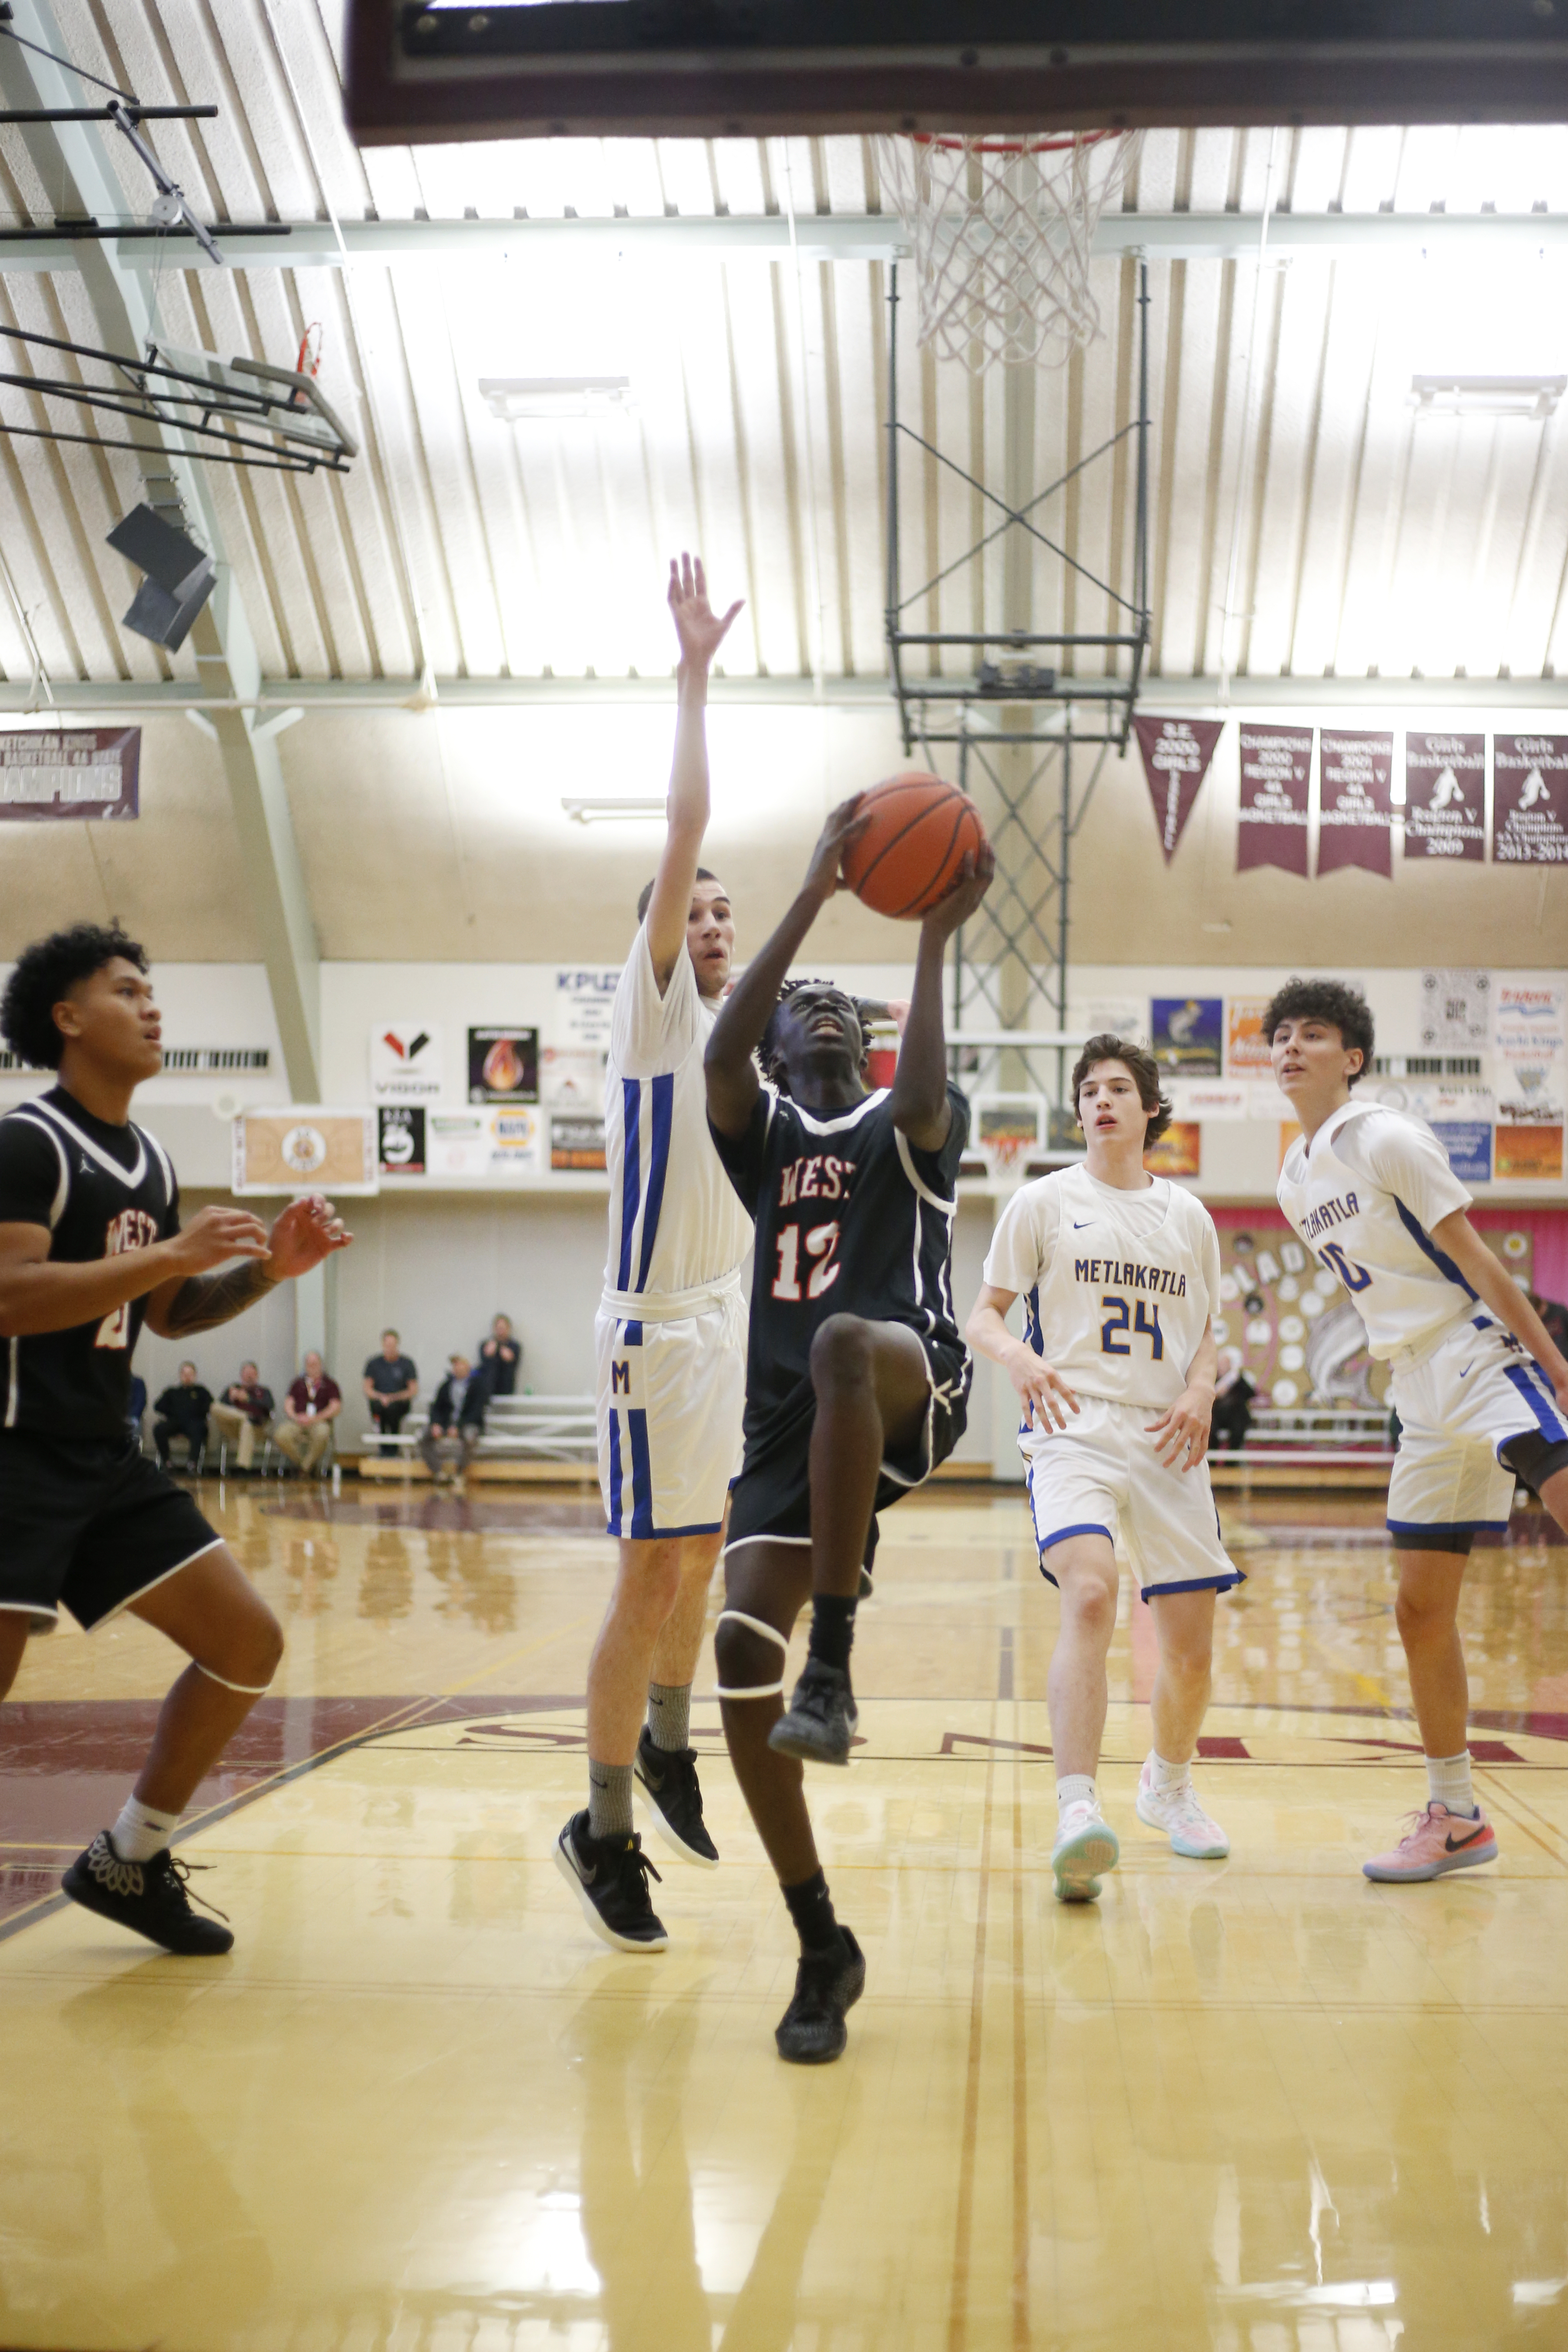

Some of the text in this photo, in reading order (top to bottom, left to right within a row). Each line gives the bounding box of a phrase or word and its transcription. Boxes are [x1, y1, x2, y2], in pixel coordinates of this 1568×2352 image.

[778, 1155, 857, 1207] WEST
[771, 1220, 841, 1302] 12
[1075, 1259, 1186, 1298] METLAKATLA
[1100, 1294, 1163, 1362] 24
[612, 1360, 630, 1395] M
